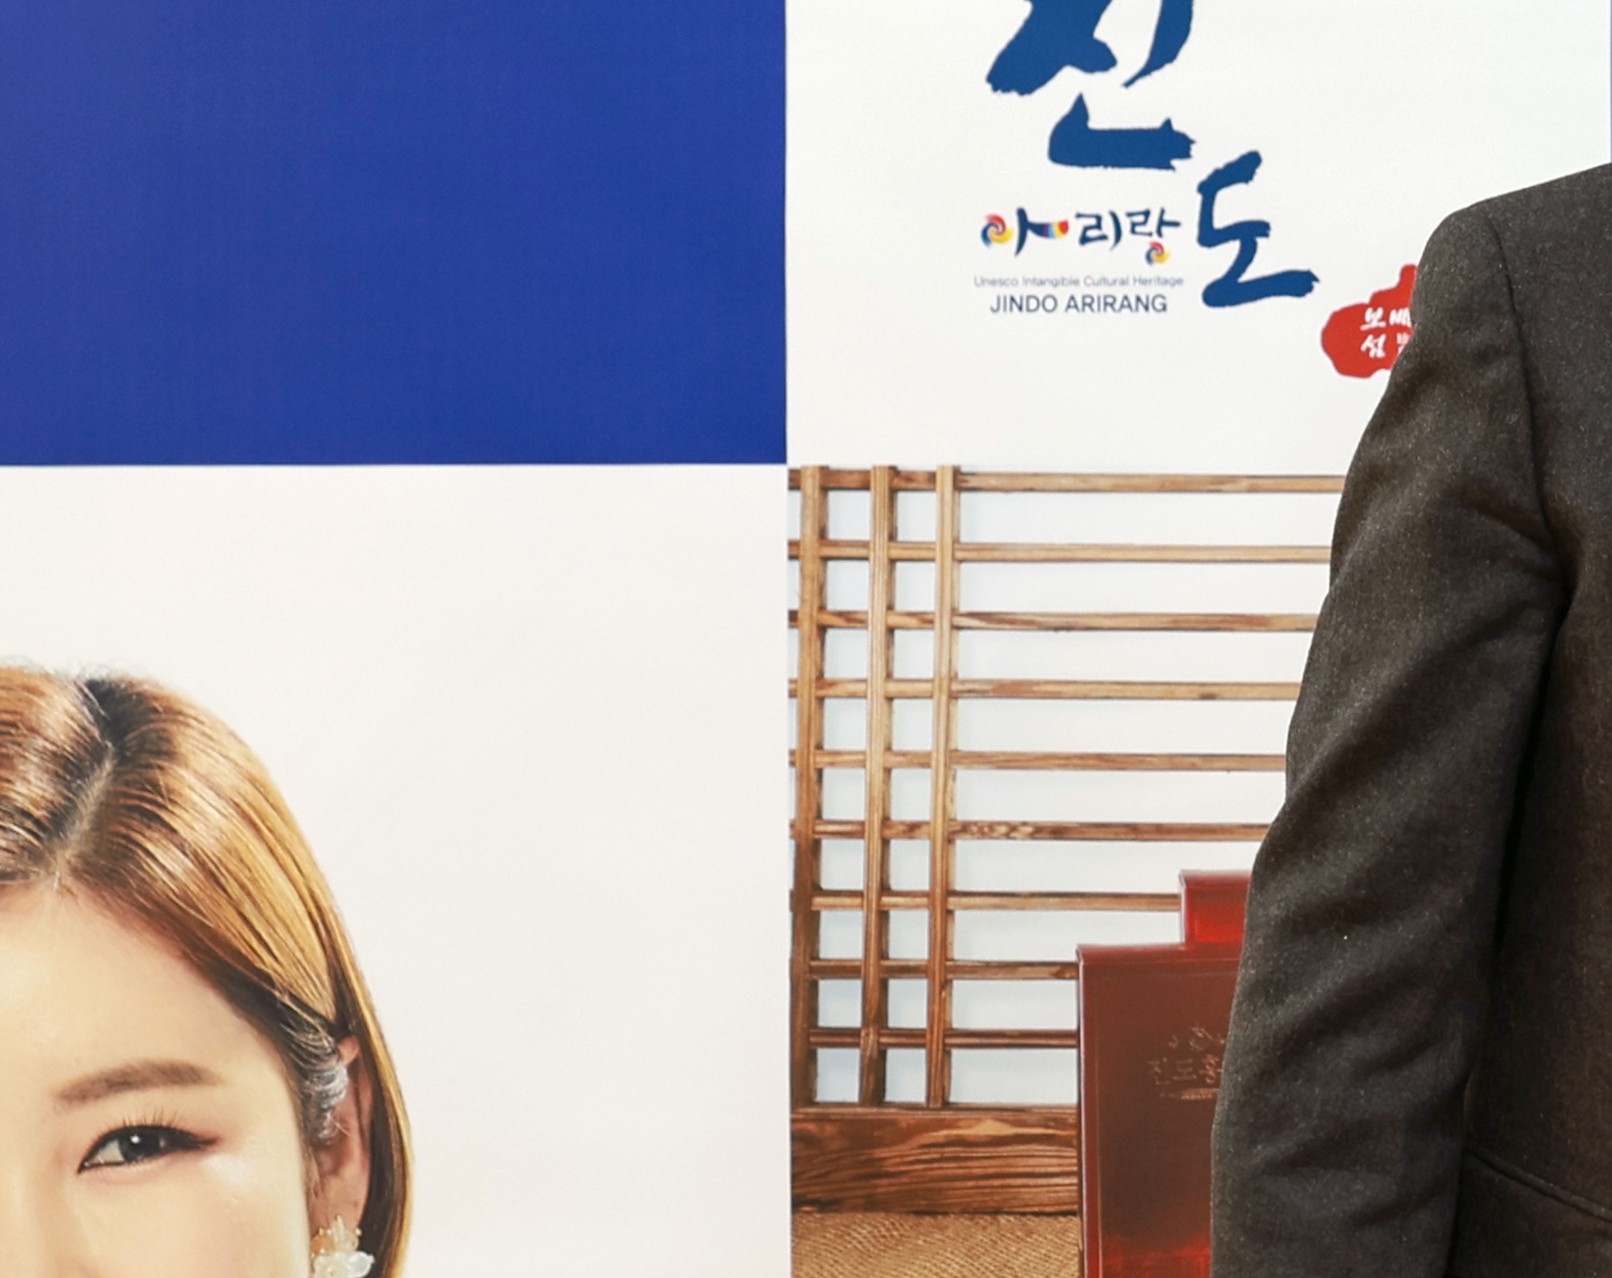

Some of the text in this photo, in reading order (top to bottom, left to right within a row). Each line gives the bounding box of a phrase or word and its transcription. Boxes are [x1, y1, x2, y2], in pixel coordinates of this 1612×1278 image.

[973, 275, 1184, 289] Unesco Intangible Cultural Heritage
[990, 294, 1168, 314] JINDO ARIRANG
